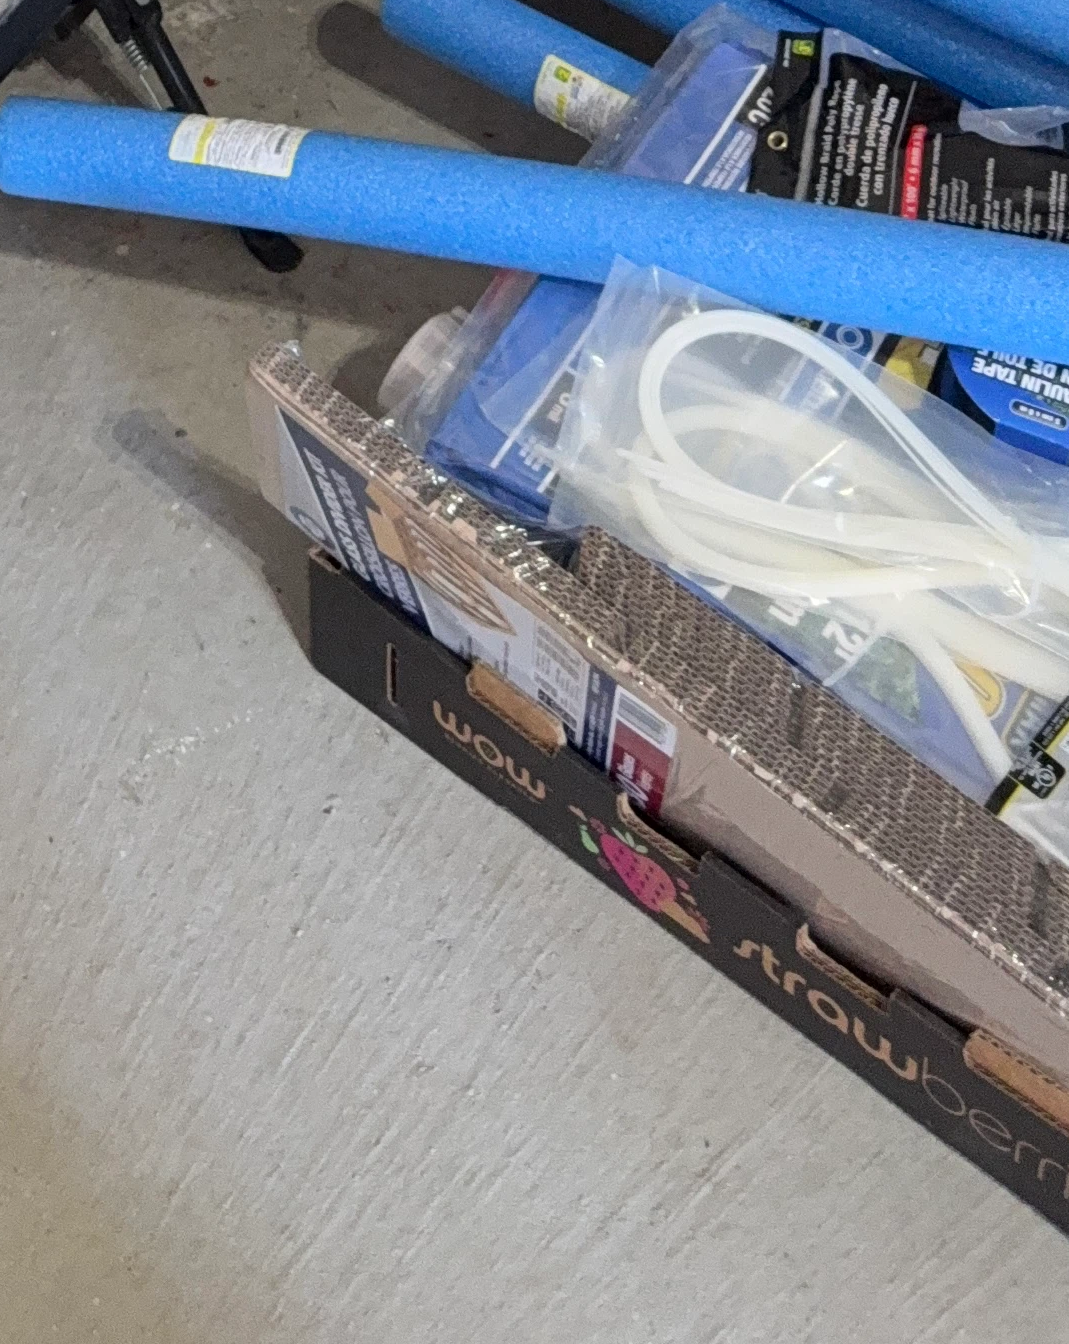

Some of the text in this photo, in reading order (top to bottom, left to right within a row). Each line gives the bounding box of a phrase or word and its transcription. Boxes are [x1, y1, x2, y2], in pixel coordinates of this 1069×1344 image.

[824, 109, 838, 133] Poly
[819, 134, 833, 164] Braid
[843, 104, 866, 177] double tresse
[873, 97, 900, 195] con trenzado hueco
[834, 155, 844, 170] en
[860, 149, 874, 164] de
[828, 172, 843, 206] Corde
[855, 166, 871, 208] Cuerda
[971, 357, 1019, 385] TAPE
[1030, 358, 1058, 380] DE
[433, 700, 546, 800] wow
